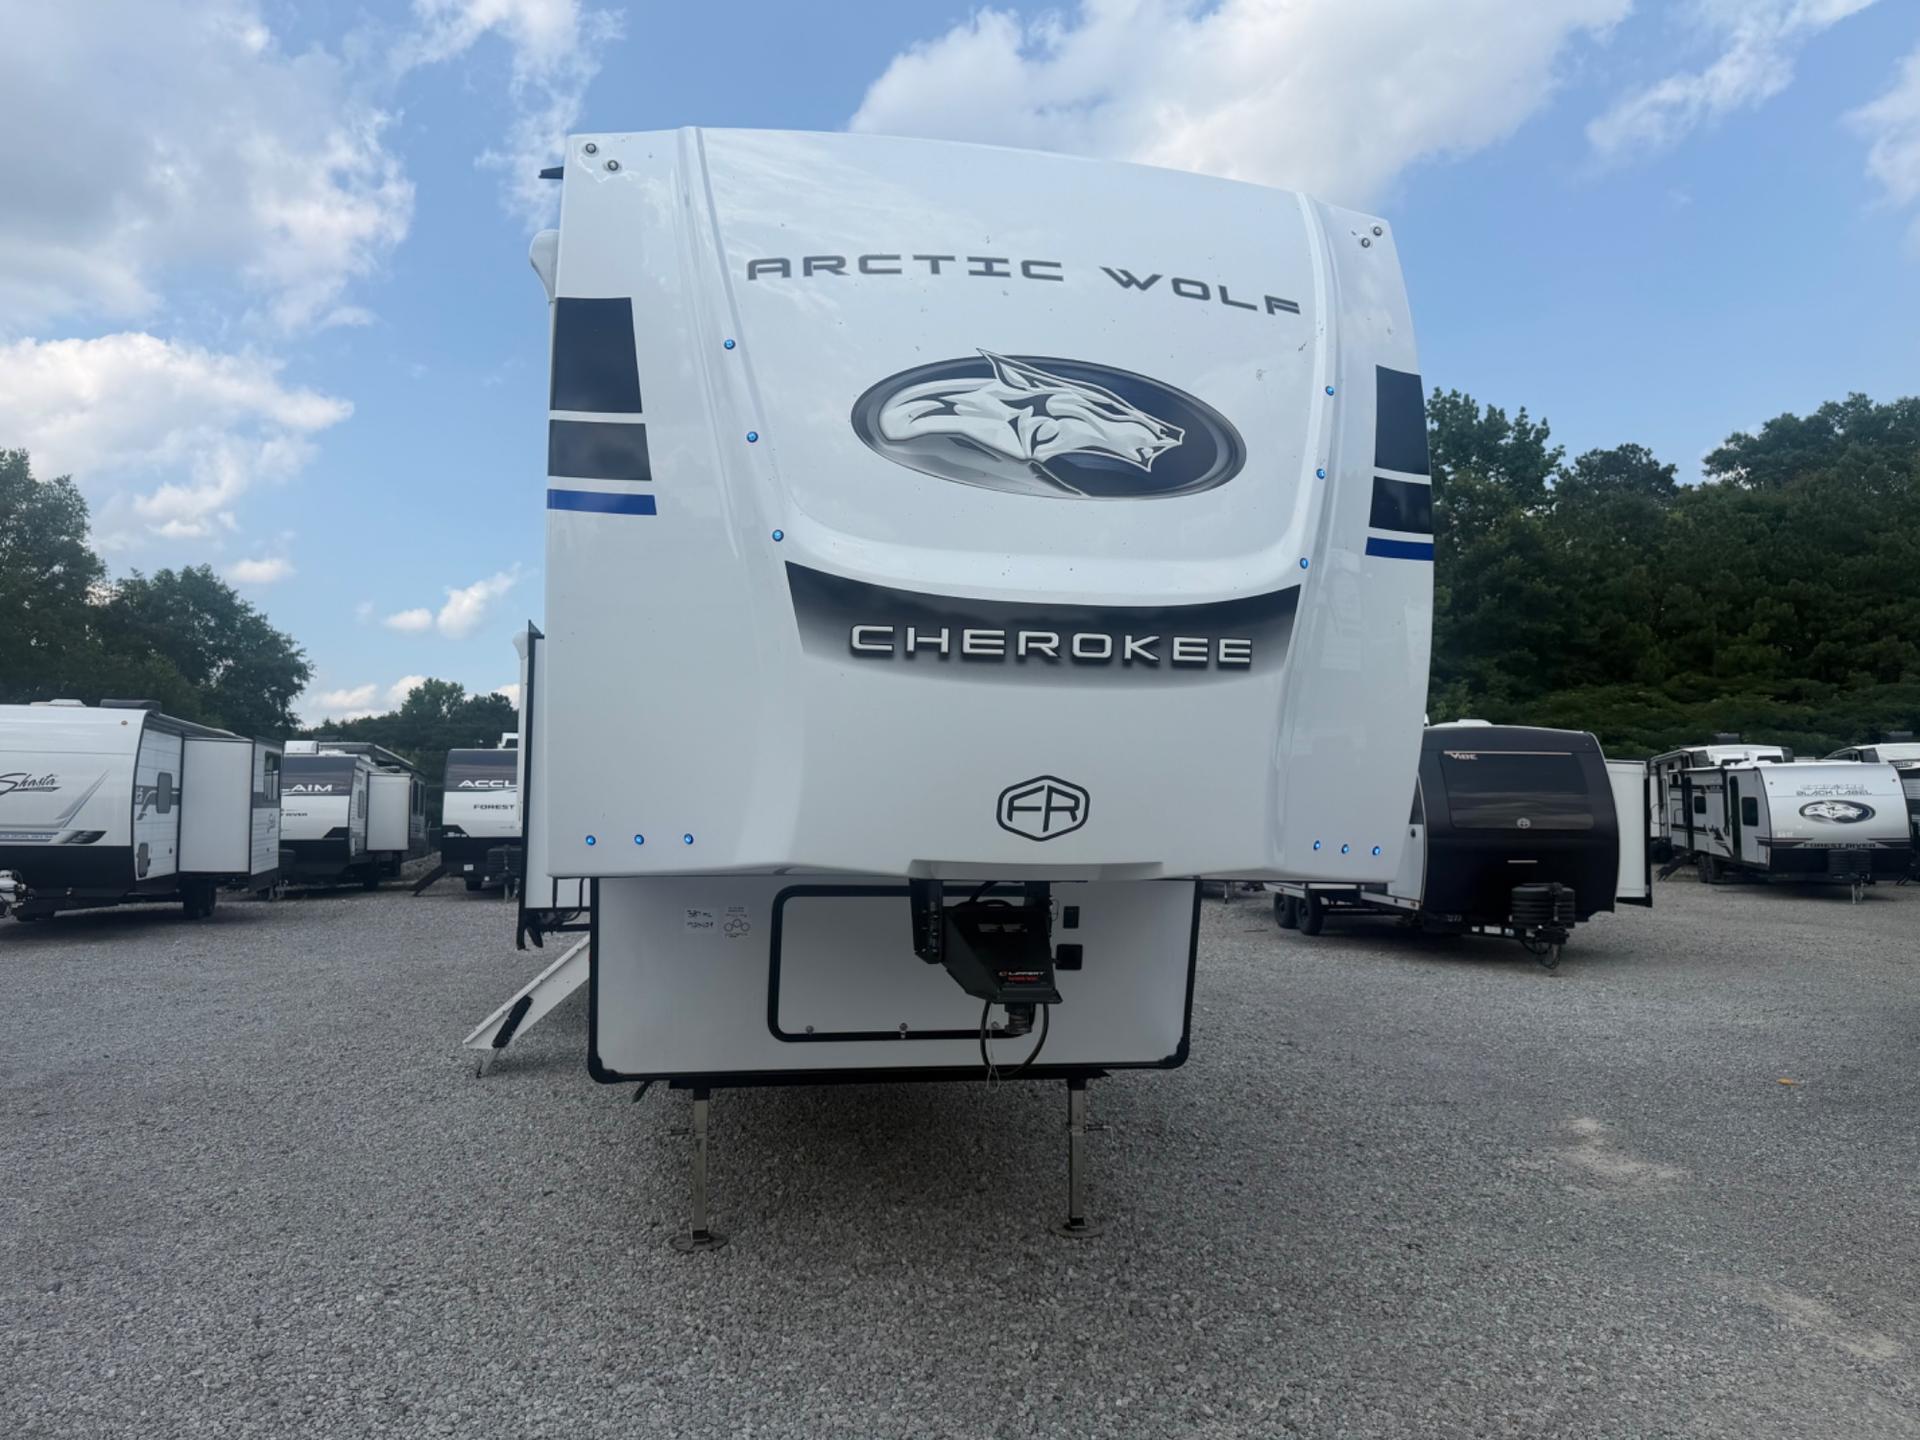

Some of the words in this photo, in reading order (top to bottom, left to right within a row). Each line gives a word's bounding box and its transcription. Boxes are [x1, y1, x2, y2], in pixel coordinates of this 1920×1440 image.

[747, 254, 1064, 282] ARCTIC
[1100, 266, 1300, 315] WOLF
[850, 624, 1253, 665] CHEROKEE
[0, 772, 57, 796] Shasta
[1006, 784, 1081, 833] FR
